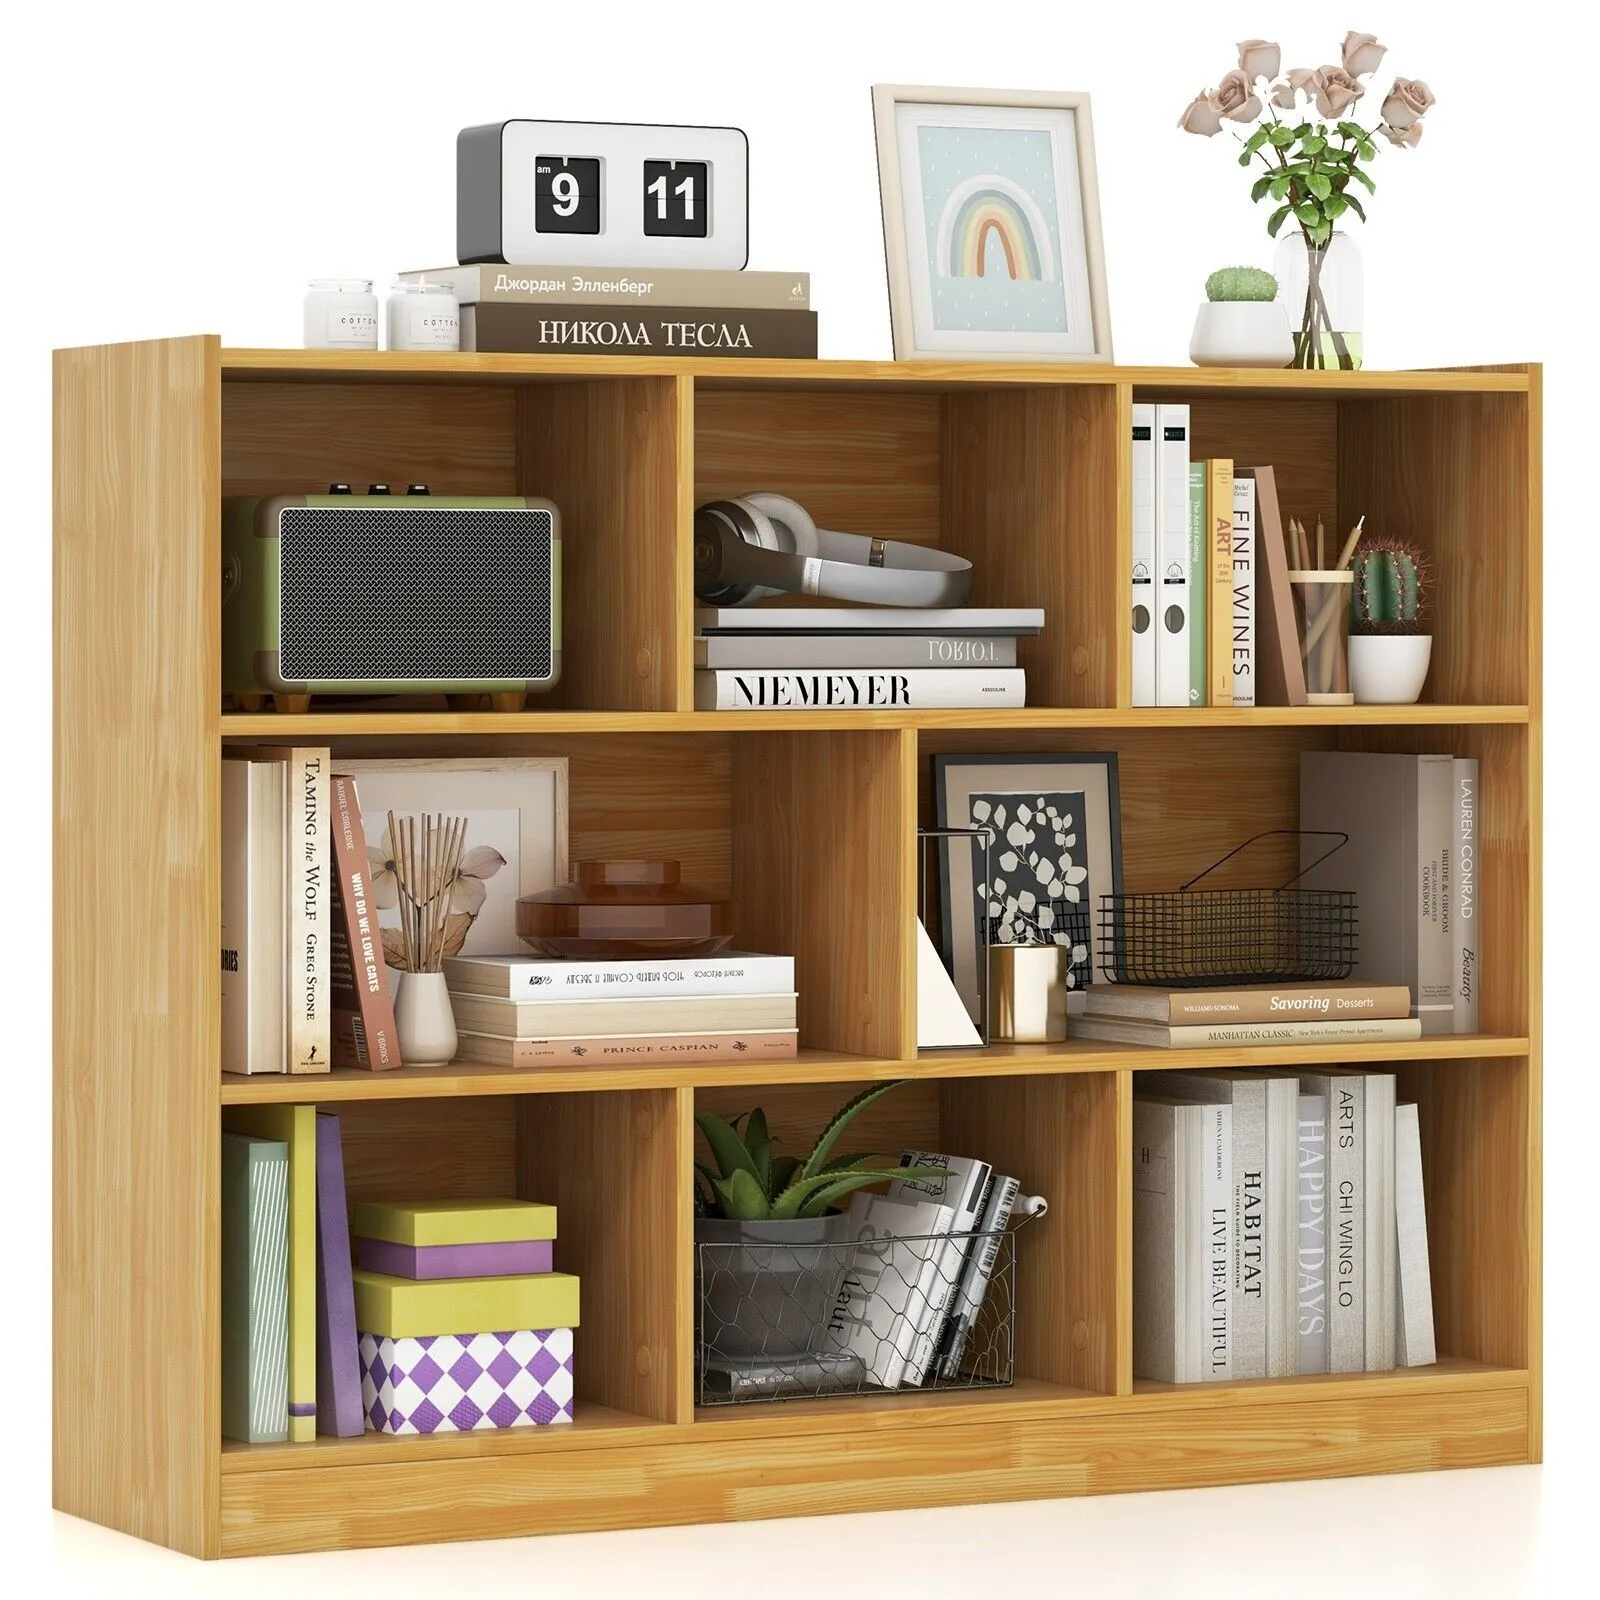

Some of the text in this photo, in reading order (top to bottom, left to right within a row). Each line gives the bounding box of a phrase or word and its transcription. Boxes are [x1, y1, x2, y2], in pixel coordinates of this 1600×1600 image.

[551, 172, 695, 220] 9 11
[494, 275, 654, 296] Джордан Элленберг
[538, 320, 753, 348] НИКОЛА ТЕСЛА
[1217, 517, 1231, 556] ART
[1232, 510, 1251, 676] FINE WINES
[731, 675, 912, 706] NIEMEYER
[1461, 779, 1473, 919] LAUREN CONRAD
[305, 758, 321, 1021] TAMING the WOLF GREG STONE
[1442, 884, 1449, 892] &
[351, 872, 380, 993] WHY DO WE LOVE CATS
[1462, 947, 1475, 1004] Beauty
[1184, 1003, 1240, 1013] WILLIAMS-SONOMA
[1270, 996, 1374, 1013] Savoring Desserts
[603, 1043, 719, 1054] PRINCE CASPIAN
[1208, 1030, 1260, 1041] MANHATTAN
[1339, 1090, 1354, 1149] ARTS
[1001, 1181, 1019, 1206] FINAL
[1244, 1171, 1262, 1298] HABITAT
[1298, 1120, 1325, 1336] HAPPY DAYS
[1339, 1181, 1353, 1308] CHI WING LO
[827, 1280, 860, 1333] Laut
[1212, 1208, 1227, 1373] LIVE BEAUTIFUL
